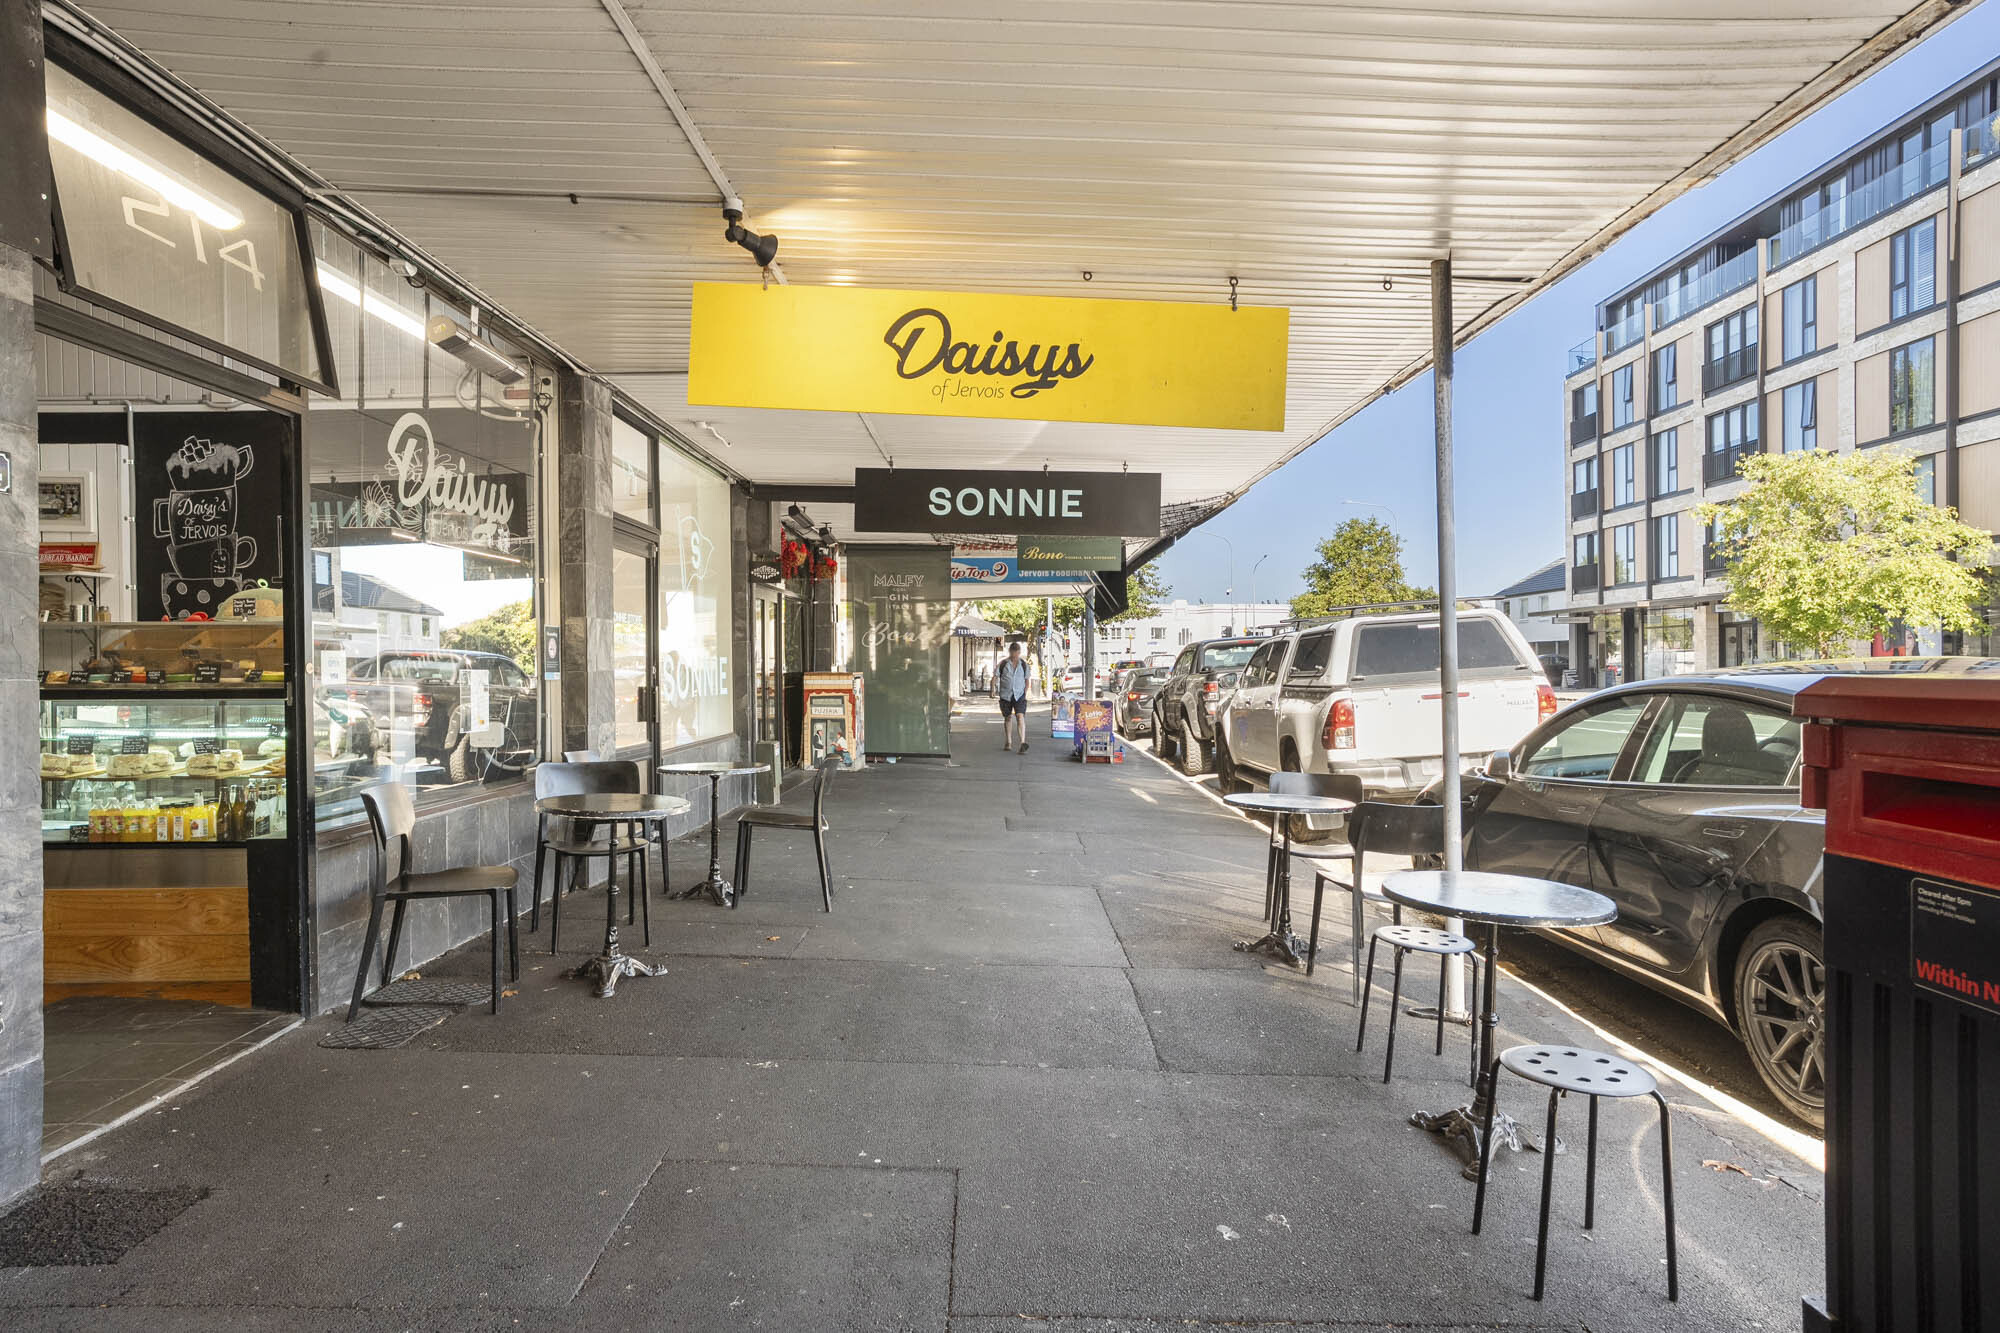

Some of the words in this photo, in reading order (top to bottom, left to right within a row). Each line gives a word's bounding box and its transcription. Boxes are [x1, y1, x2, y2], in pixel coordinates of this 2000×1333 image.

[884, 307, 1094, 399] Daisys
[932, 379, 950, 403] of
[951, 379, 1004, 399] Jervois
[387, 412, 514, 541] Daisys
[177, 496, 229, 522] Daisy's
[928, 486, 1083, 518] SONNIE
[180, 524, 228, 539] JERVOIS
[184, 517, 195, 527] OF
[690, 531, 702, 569] S
[1022, 546, 1065, 560] Bono
[873, 573, 925, 587] MALFY
[951, 567, 966, 580] ip
[966, 566, 990, 579] Top
[1018, 569, 1049, 577] Jervois
[889, 593, 909, 601] GIN
[663, 655, 729, 702] SONNIE
[1085, 710, 1103, 718] Lotto
[1916, 958, 1979, 997] Within
